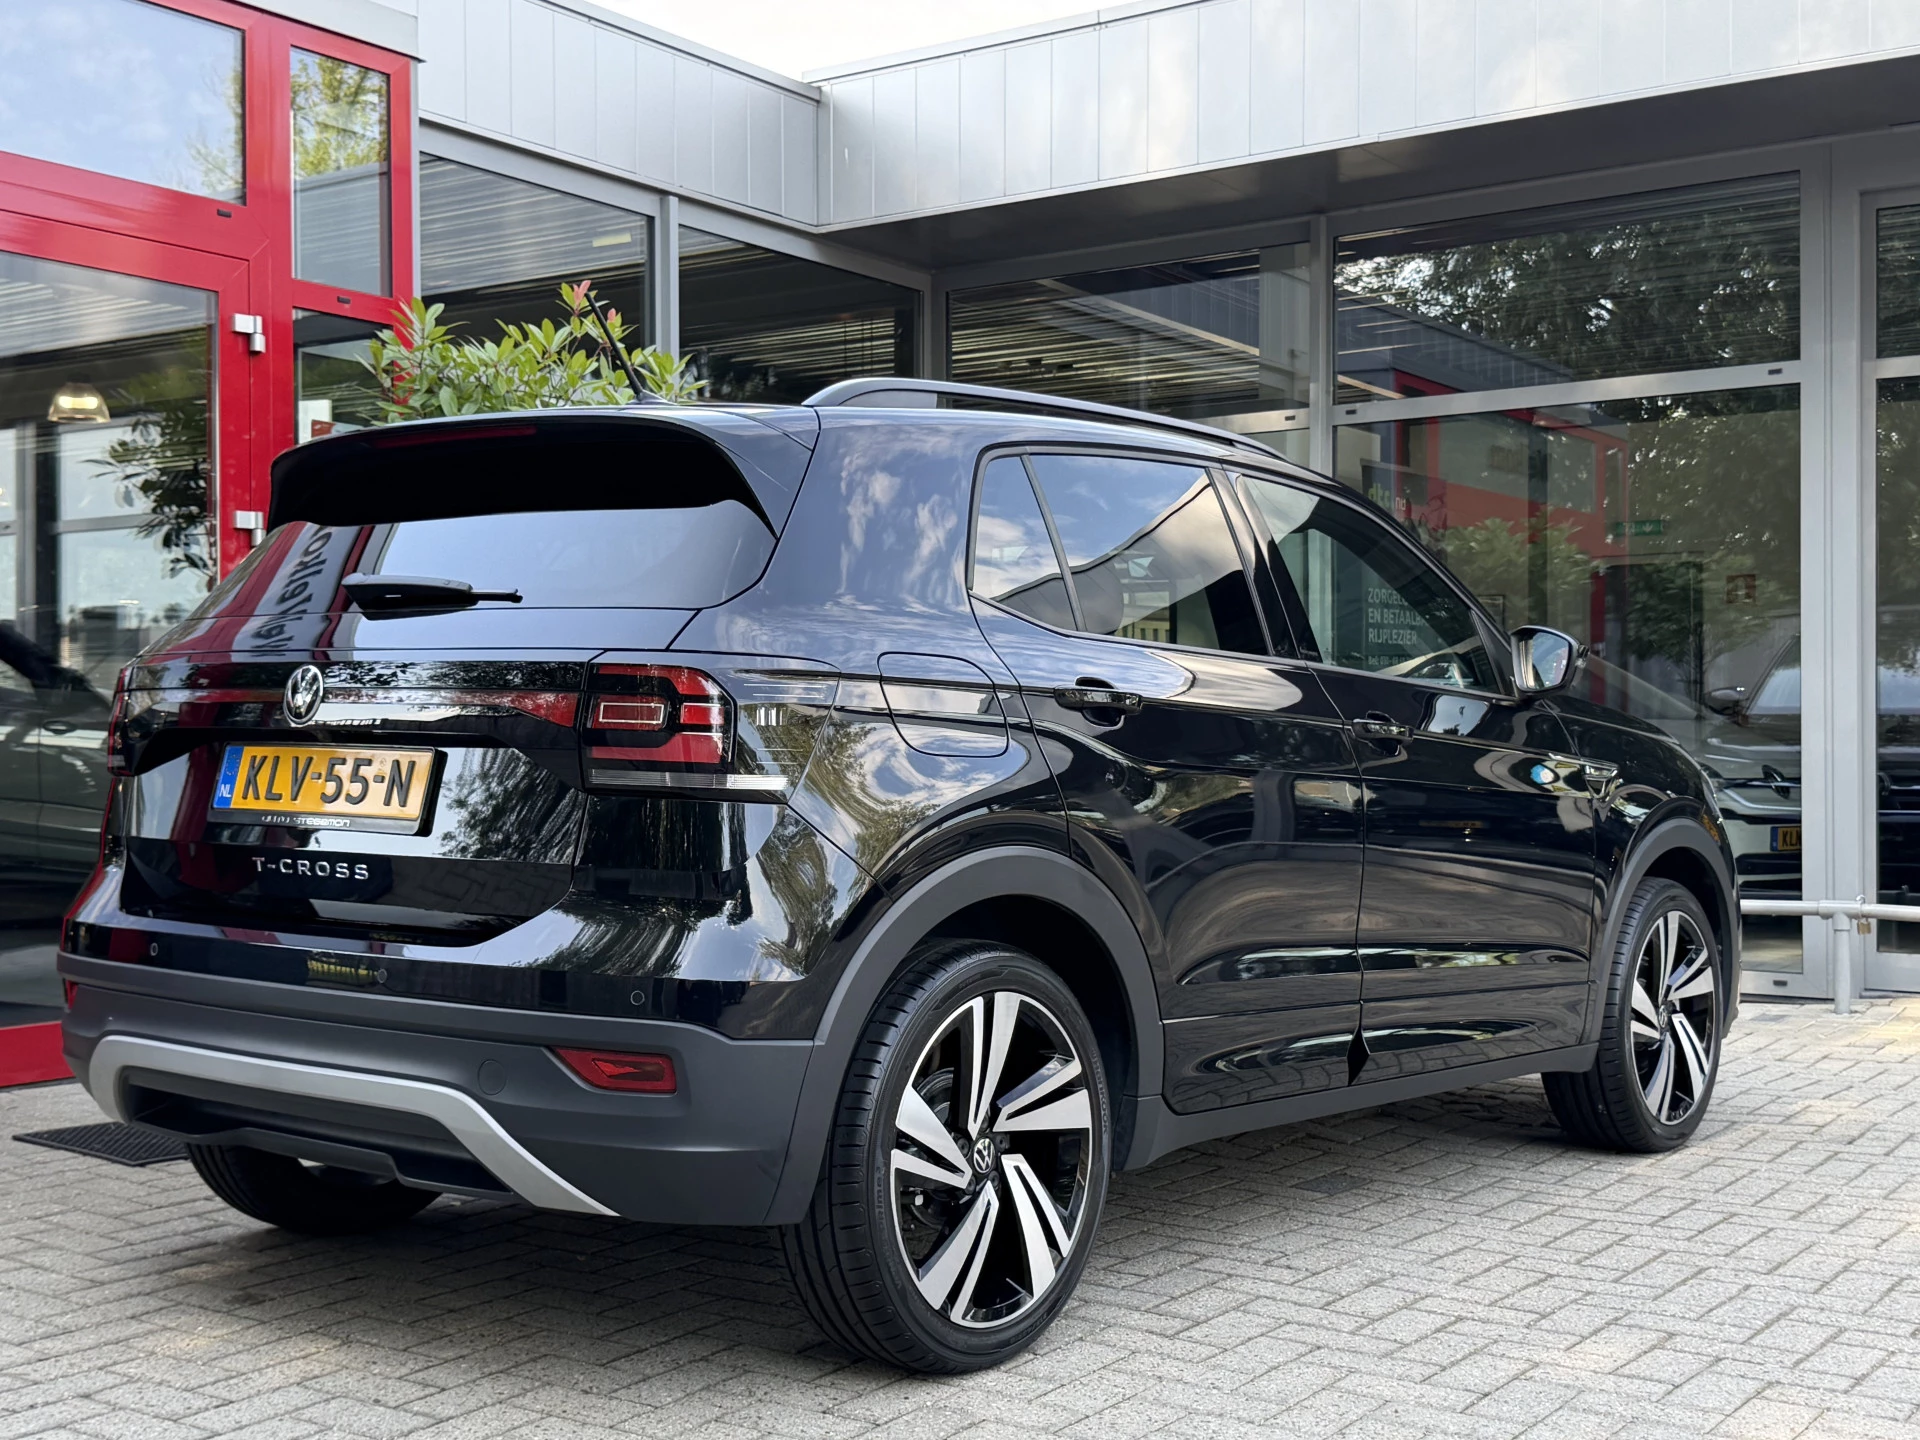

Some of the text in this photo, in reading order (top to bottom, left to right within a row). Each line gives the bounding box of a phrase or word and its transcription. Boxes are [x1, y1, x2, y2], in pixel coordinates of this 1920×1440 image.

[1368, 608, 1381, 623] EN
[1368, 628, 1417, 645] RIJPLEZIER
[241, 754, 417, 807] KLV-55-N
[219, 783, 232, 798] NL
[251, 856, 370, 881] T-CROSS
